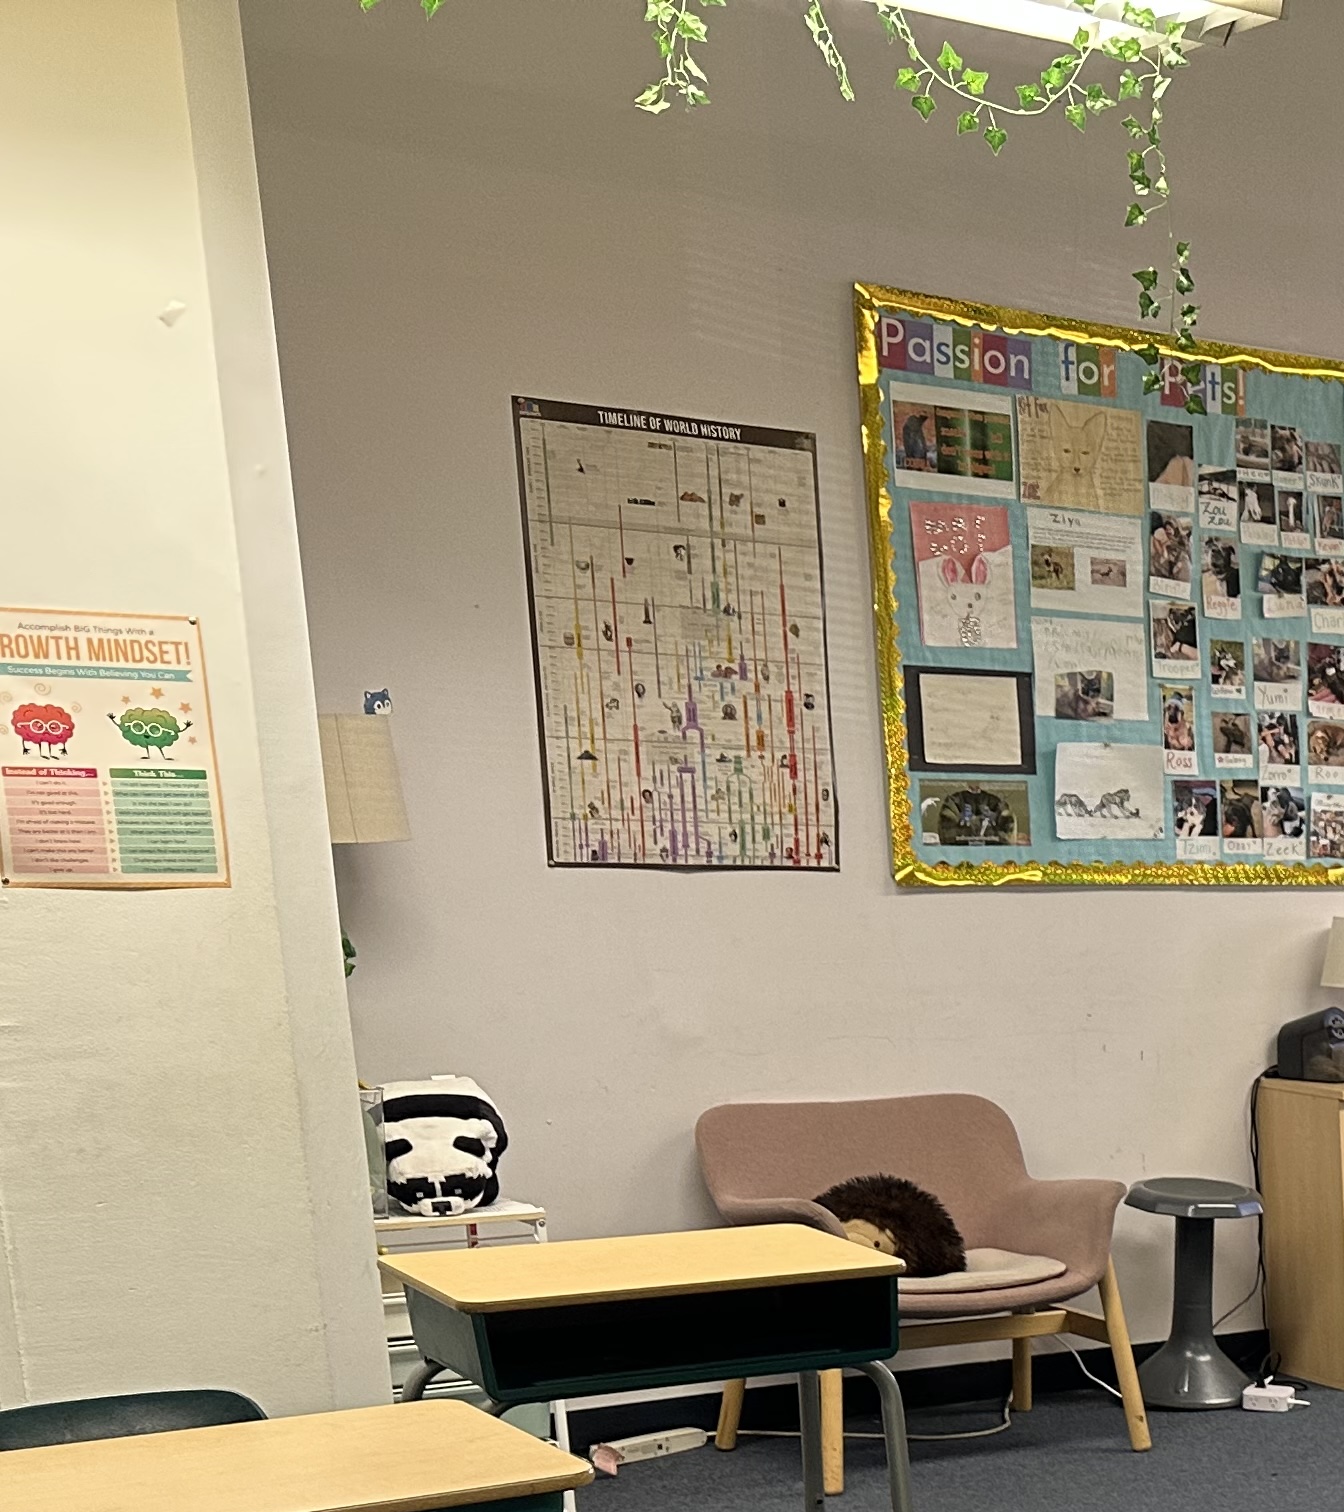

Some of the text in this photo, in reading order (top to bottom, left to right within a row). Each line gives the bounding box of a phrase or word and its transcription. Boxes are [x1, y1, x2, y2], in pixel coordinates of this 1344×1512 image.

[881, 317, 1029, 380] Passion
[1061, 342, 1116, 386] for
[597, 410, 742, 441] TIMELINE OF WORLD HISTORY
[17, 622, 72, 633] Accomplish
[74, 625, 91, 633] BIG
[93, 625, 123, 637] Things
[125, 627, 147, 636] With
[86, 637, 191, 666] MINDSET!
[7, 666, 175, 679] Success Begins With Believing You Can
[1257, 686, 1289, 707] Yumi
[1315, 767, 1339, 780] Roo
